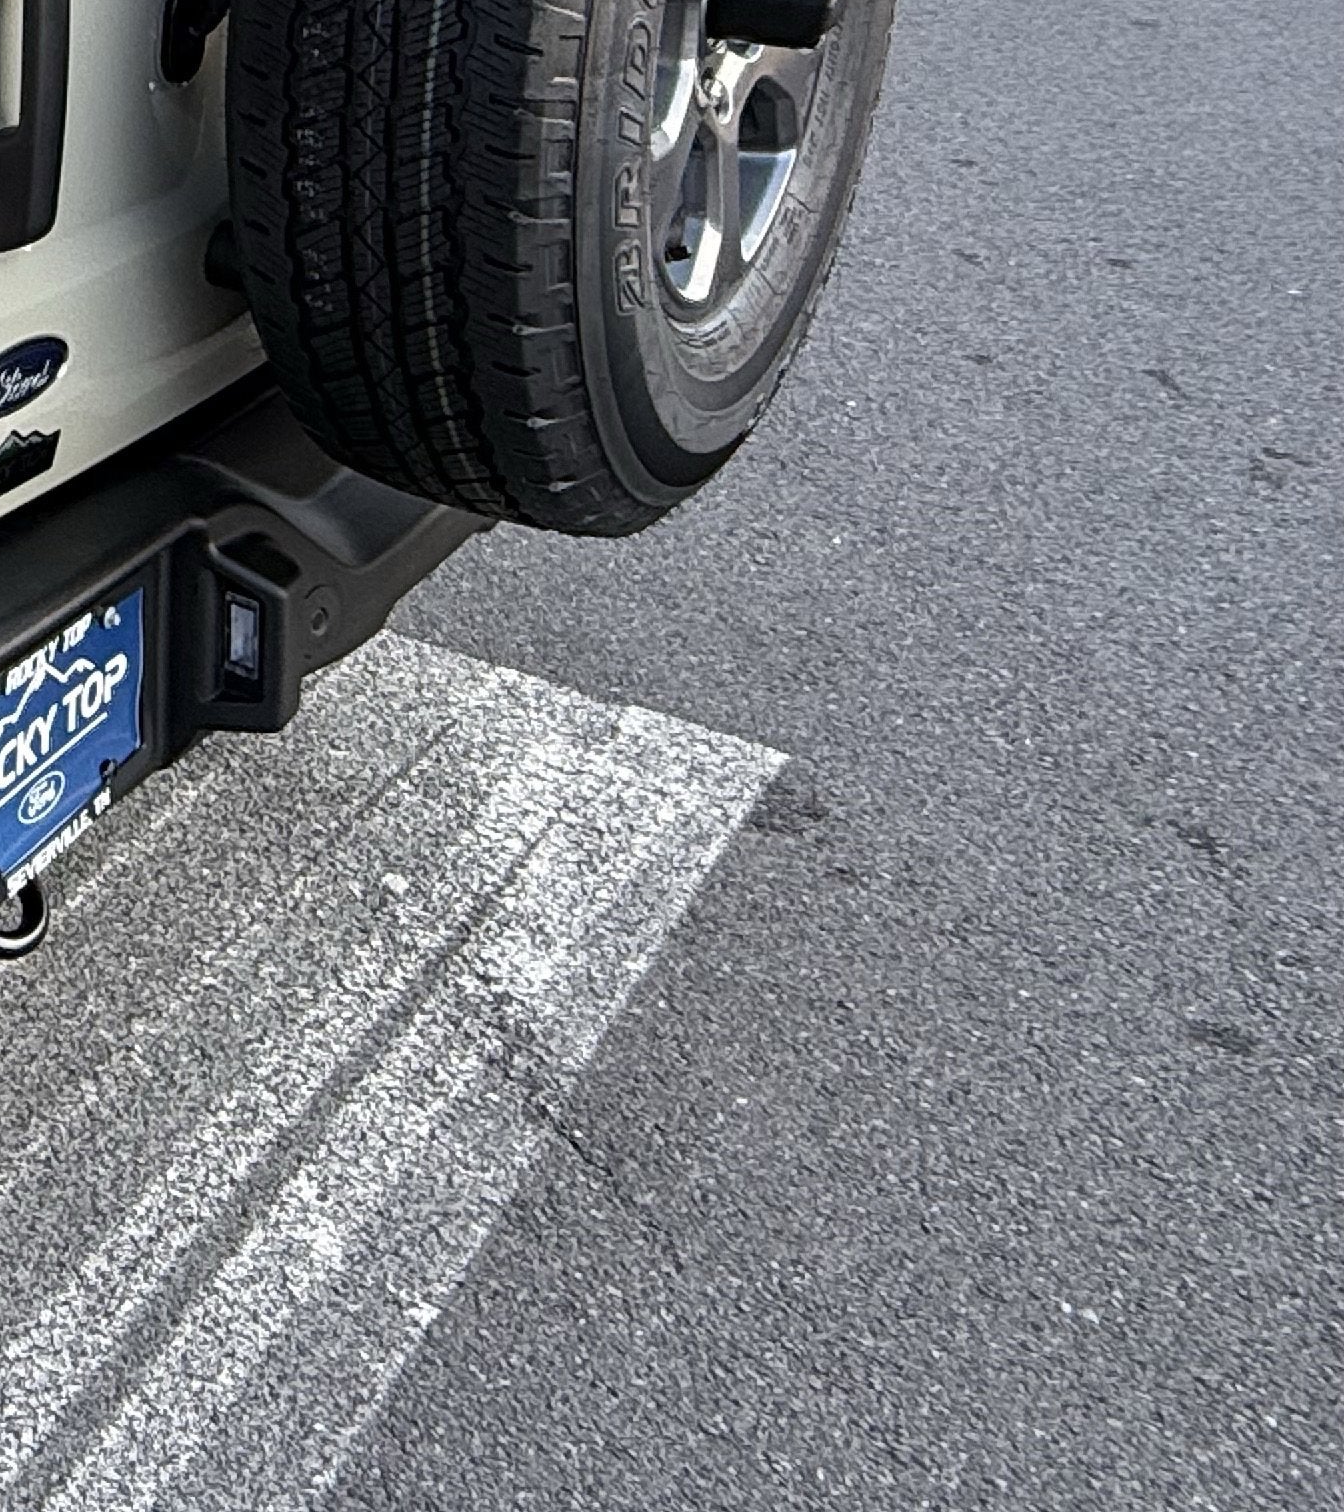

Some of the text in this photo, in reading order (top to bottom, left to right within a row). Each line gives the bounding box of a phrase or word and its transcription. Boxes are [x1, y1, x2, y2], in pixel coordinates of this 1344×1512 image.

[62, 612, 92, 653] TOP
[62, 652, 128, 733] TOP
[93, 786, 111, 816] TN
